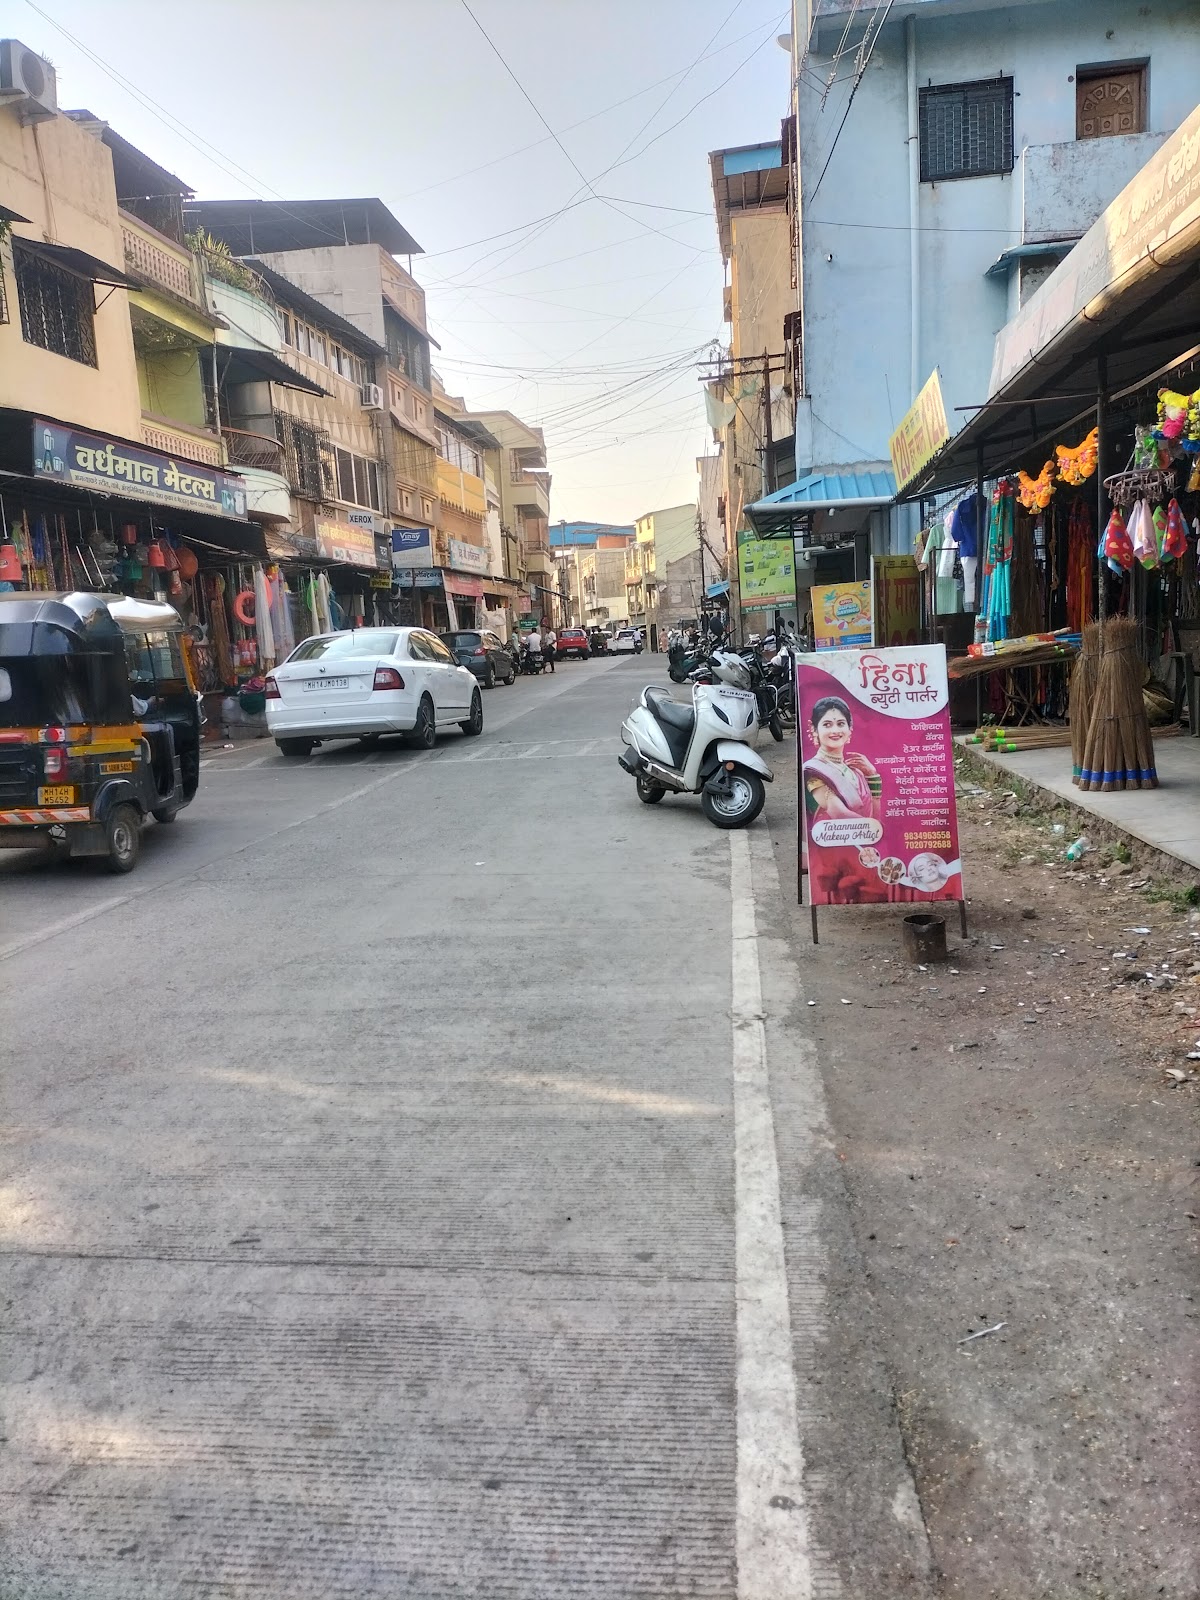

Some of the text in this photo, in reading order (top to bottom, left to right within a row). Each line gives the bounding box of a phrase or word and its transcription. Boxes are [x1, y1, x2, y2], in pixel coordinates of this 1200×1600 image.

[75, 444, 216, 500] वर्धमान मेटल्स
[350, 514, 372, 524] XEROX
[400, 532, 420, 542] Vinay
[858, 655, 928, 691] हिना
[870, 686, 938, 709] ब्युटी पार्लर
[911, 722, 943, 730] फेशियल
[903, 744, 920, 753] हेअर
[908, 753, 945, 763] स्पेशालिटी
[891, 766, 911, 774] पार्लर
[917, 775, 947, 784] क्लासेस
[44, 787, 69, 795] MH14H
[899, 785, 947, 795] घेतले जातील
[887, 797, 906, 806] तसेच
[824, 822, 870, 831] Tarannuam
[816, 831, 850, 843] Makeup
[904, 831, 951, 840] 9834963558
[905, 840, 951, 849] 7020792688
